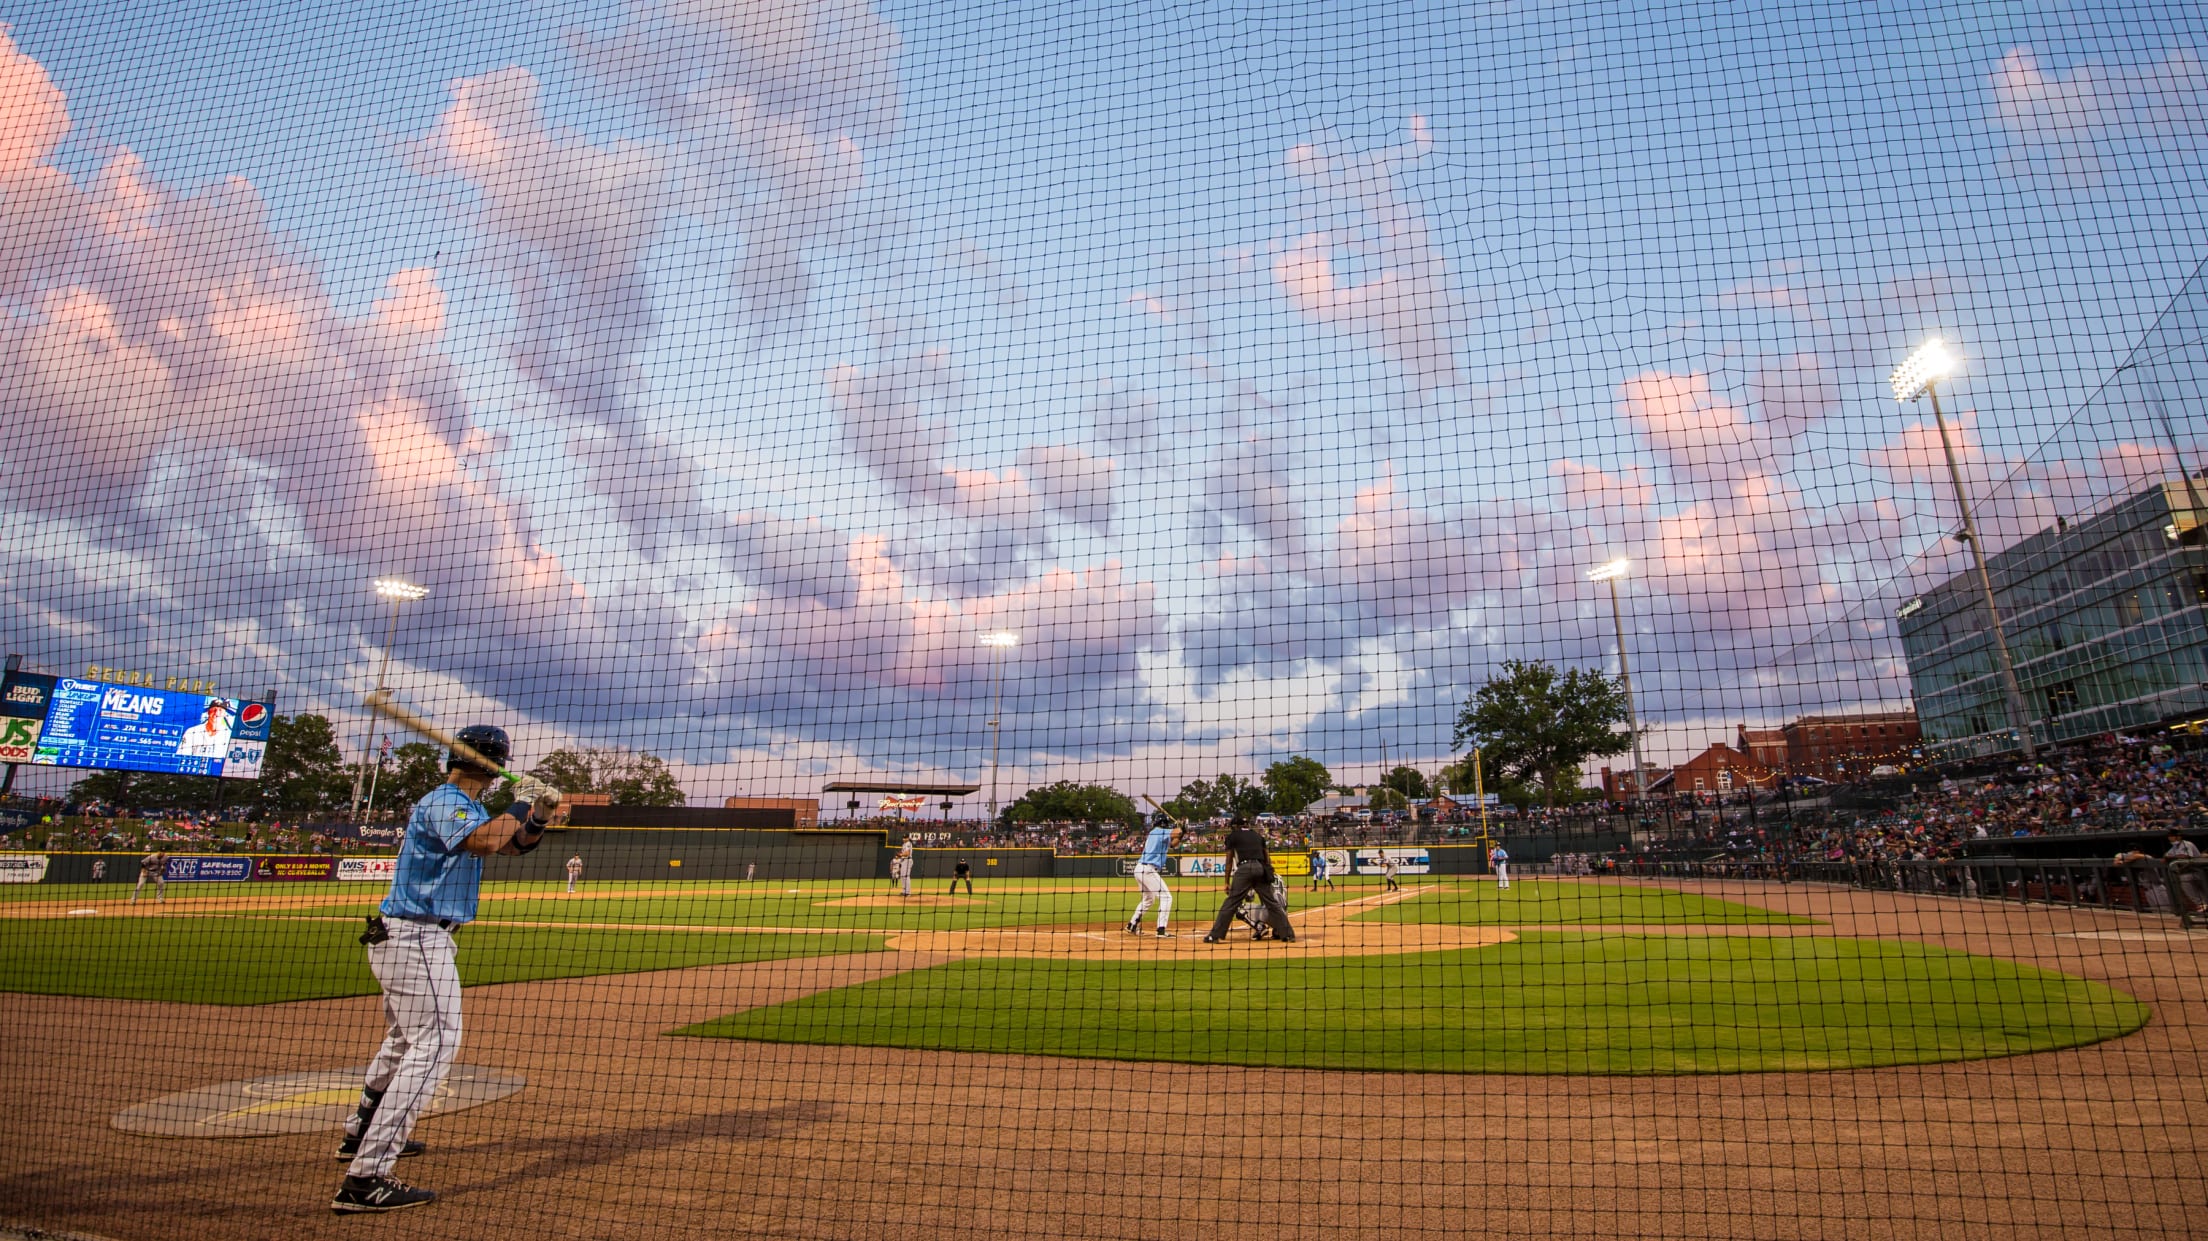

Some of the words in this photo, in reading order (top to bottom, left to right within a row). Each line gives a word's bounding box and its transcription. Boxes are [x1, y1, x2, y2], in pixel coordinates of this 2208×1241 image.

[87, 664, 153, 687] SEGRA
[166, 676, 216, 695] PARK
[12, 685, 41, 695] BUD
[6, 692, 44, 704] LIGHT
[101, 691, 164, 715] MEANS
[240, 729, 261, 737] pepsi
[0, 746, 28, 758] ODS
[878, 799, 925, 809] Budweiser
[360, 825, 395, 837] Bojangles
[168, 859, 198, 874] SAFE
[343, 861, 365, 869] WIS
